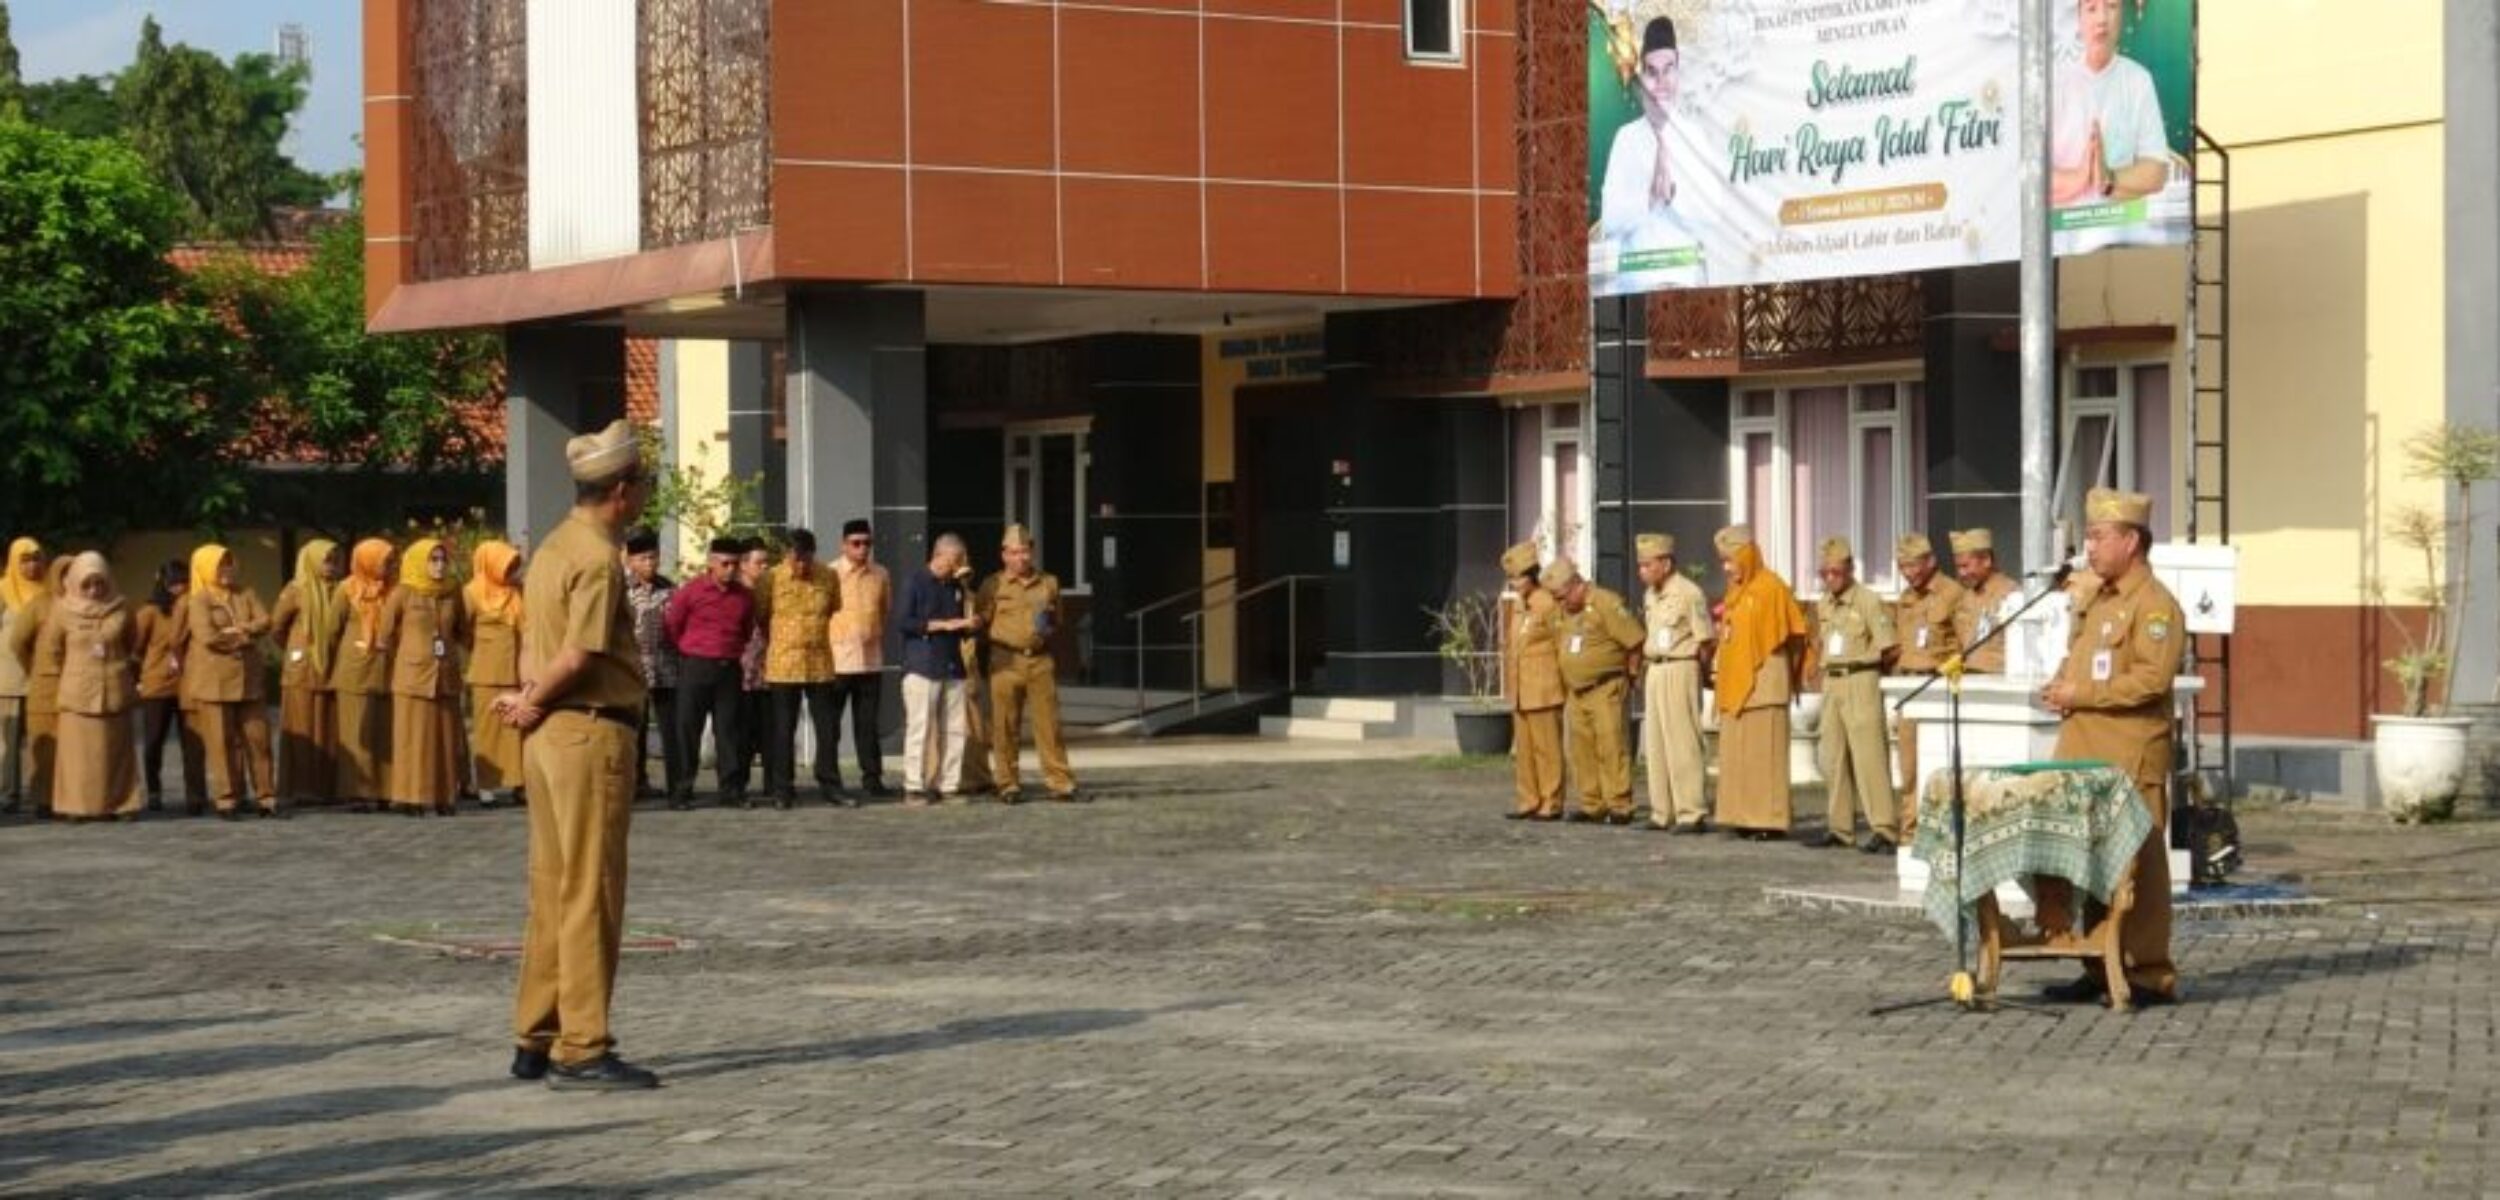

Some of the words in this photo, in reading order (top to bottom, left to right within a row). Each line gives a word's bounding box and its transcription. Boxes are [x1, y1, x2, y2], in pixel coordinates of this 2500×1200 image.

[1806, 54, 1917, 108] Selamat
[1728, 132, 1789, 183] Hari
[1796, 122, 1865, 184] Raya
[1875, 114, 1931, 167] Idul
[1938, 100, 2003, 156] Fitri
